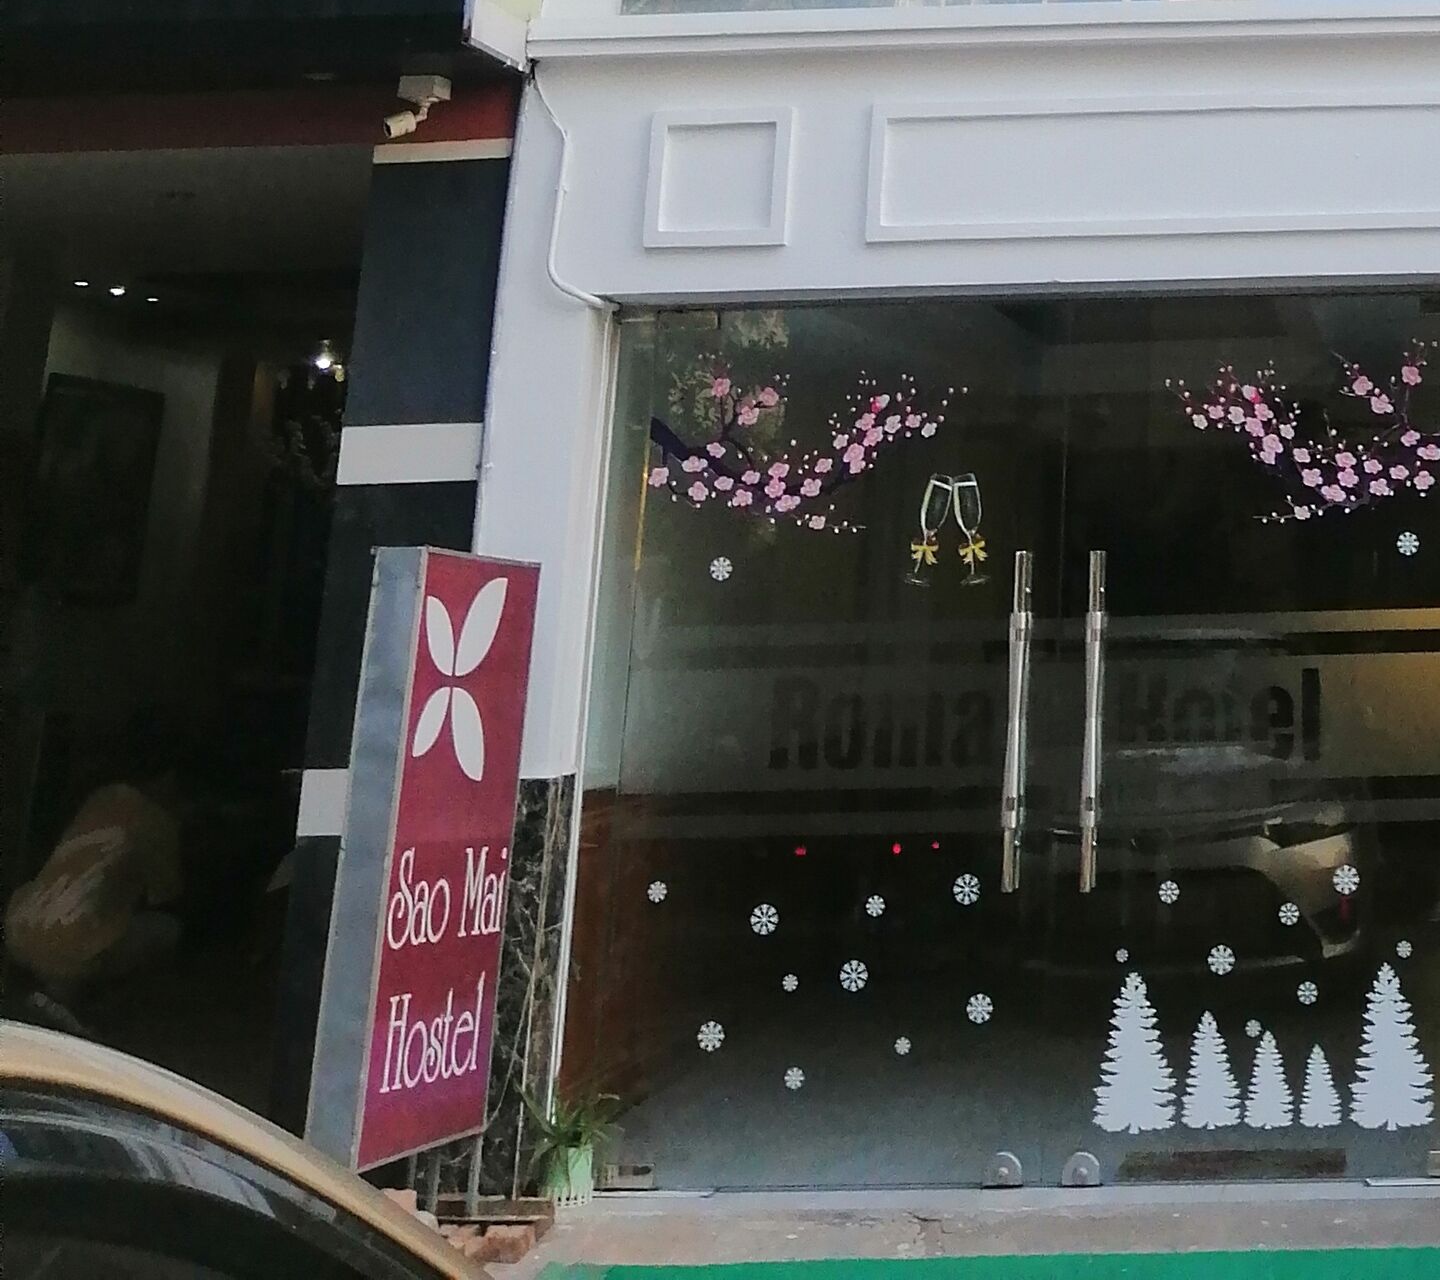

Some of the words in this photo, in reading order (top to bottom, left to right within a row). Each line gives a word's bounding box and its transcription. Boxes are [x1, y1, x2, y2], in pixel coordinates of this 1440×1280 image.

[387, 847, 450, 951] Sao
[457, 845, 507, 937] Mai
[379, 970, 487, 1094] Hostel
